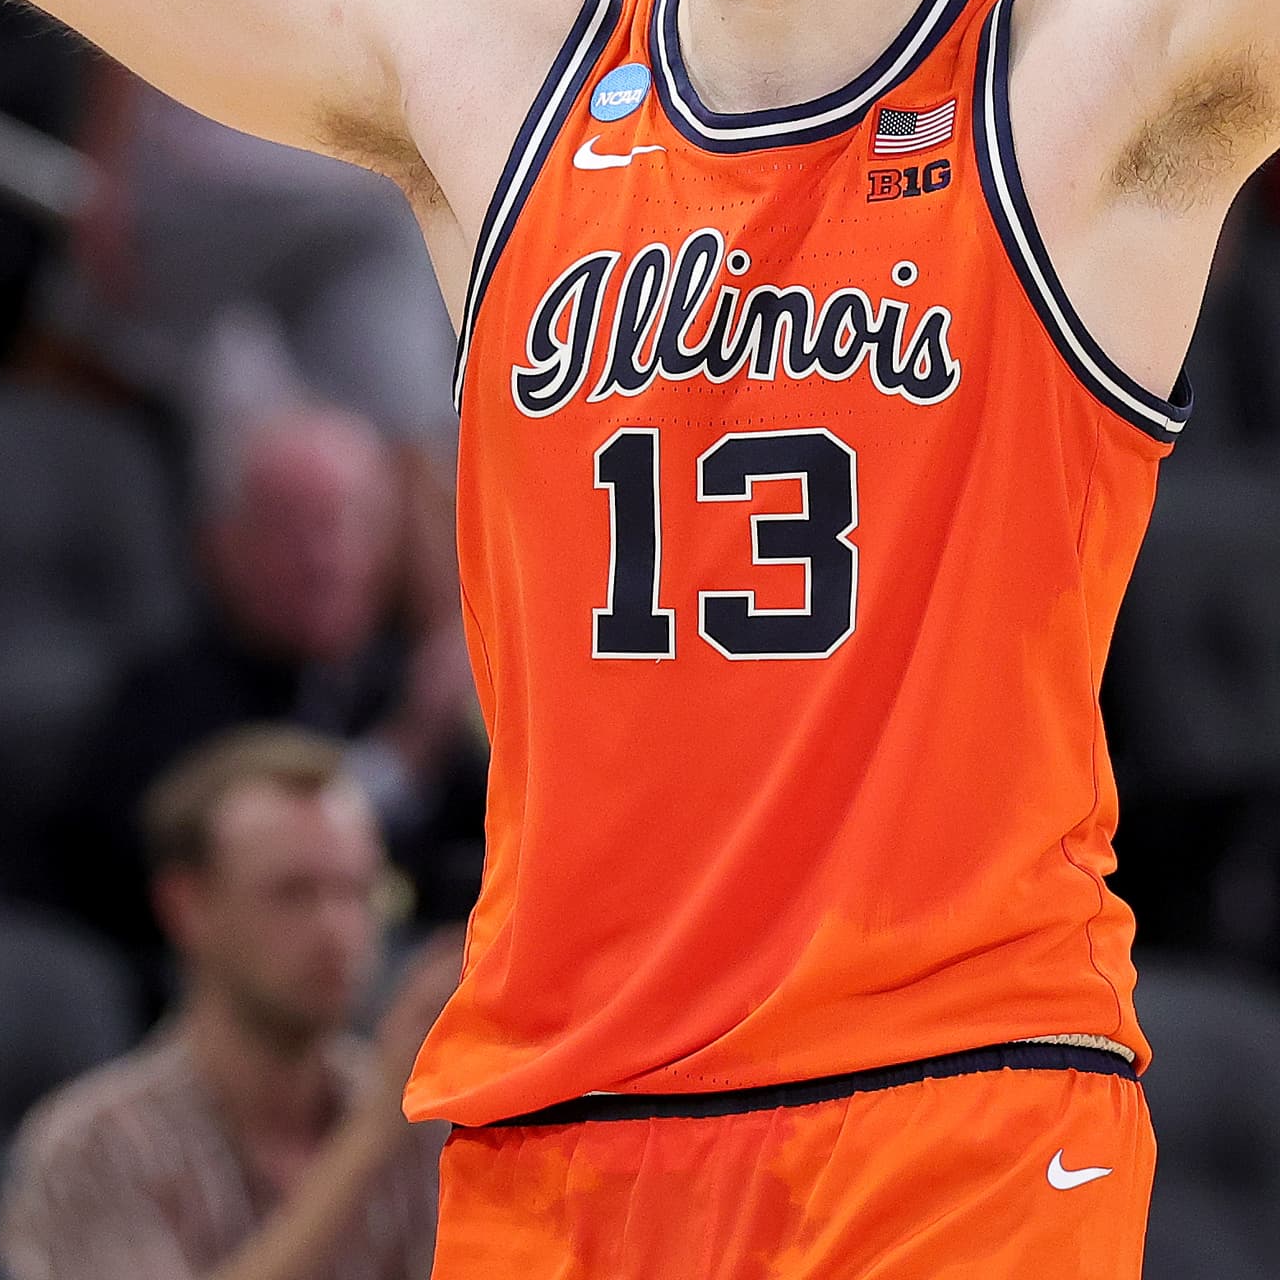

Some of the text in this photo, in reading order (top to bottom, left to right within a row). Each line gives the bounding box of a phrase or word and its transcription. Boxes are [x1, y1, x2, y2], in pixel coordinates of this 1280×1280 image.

[595, 88, 642, 108] NCAA
[511, 227, 961, 419] Illinois
[591, 426, 859, 661] 13
